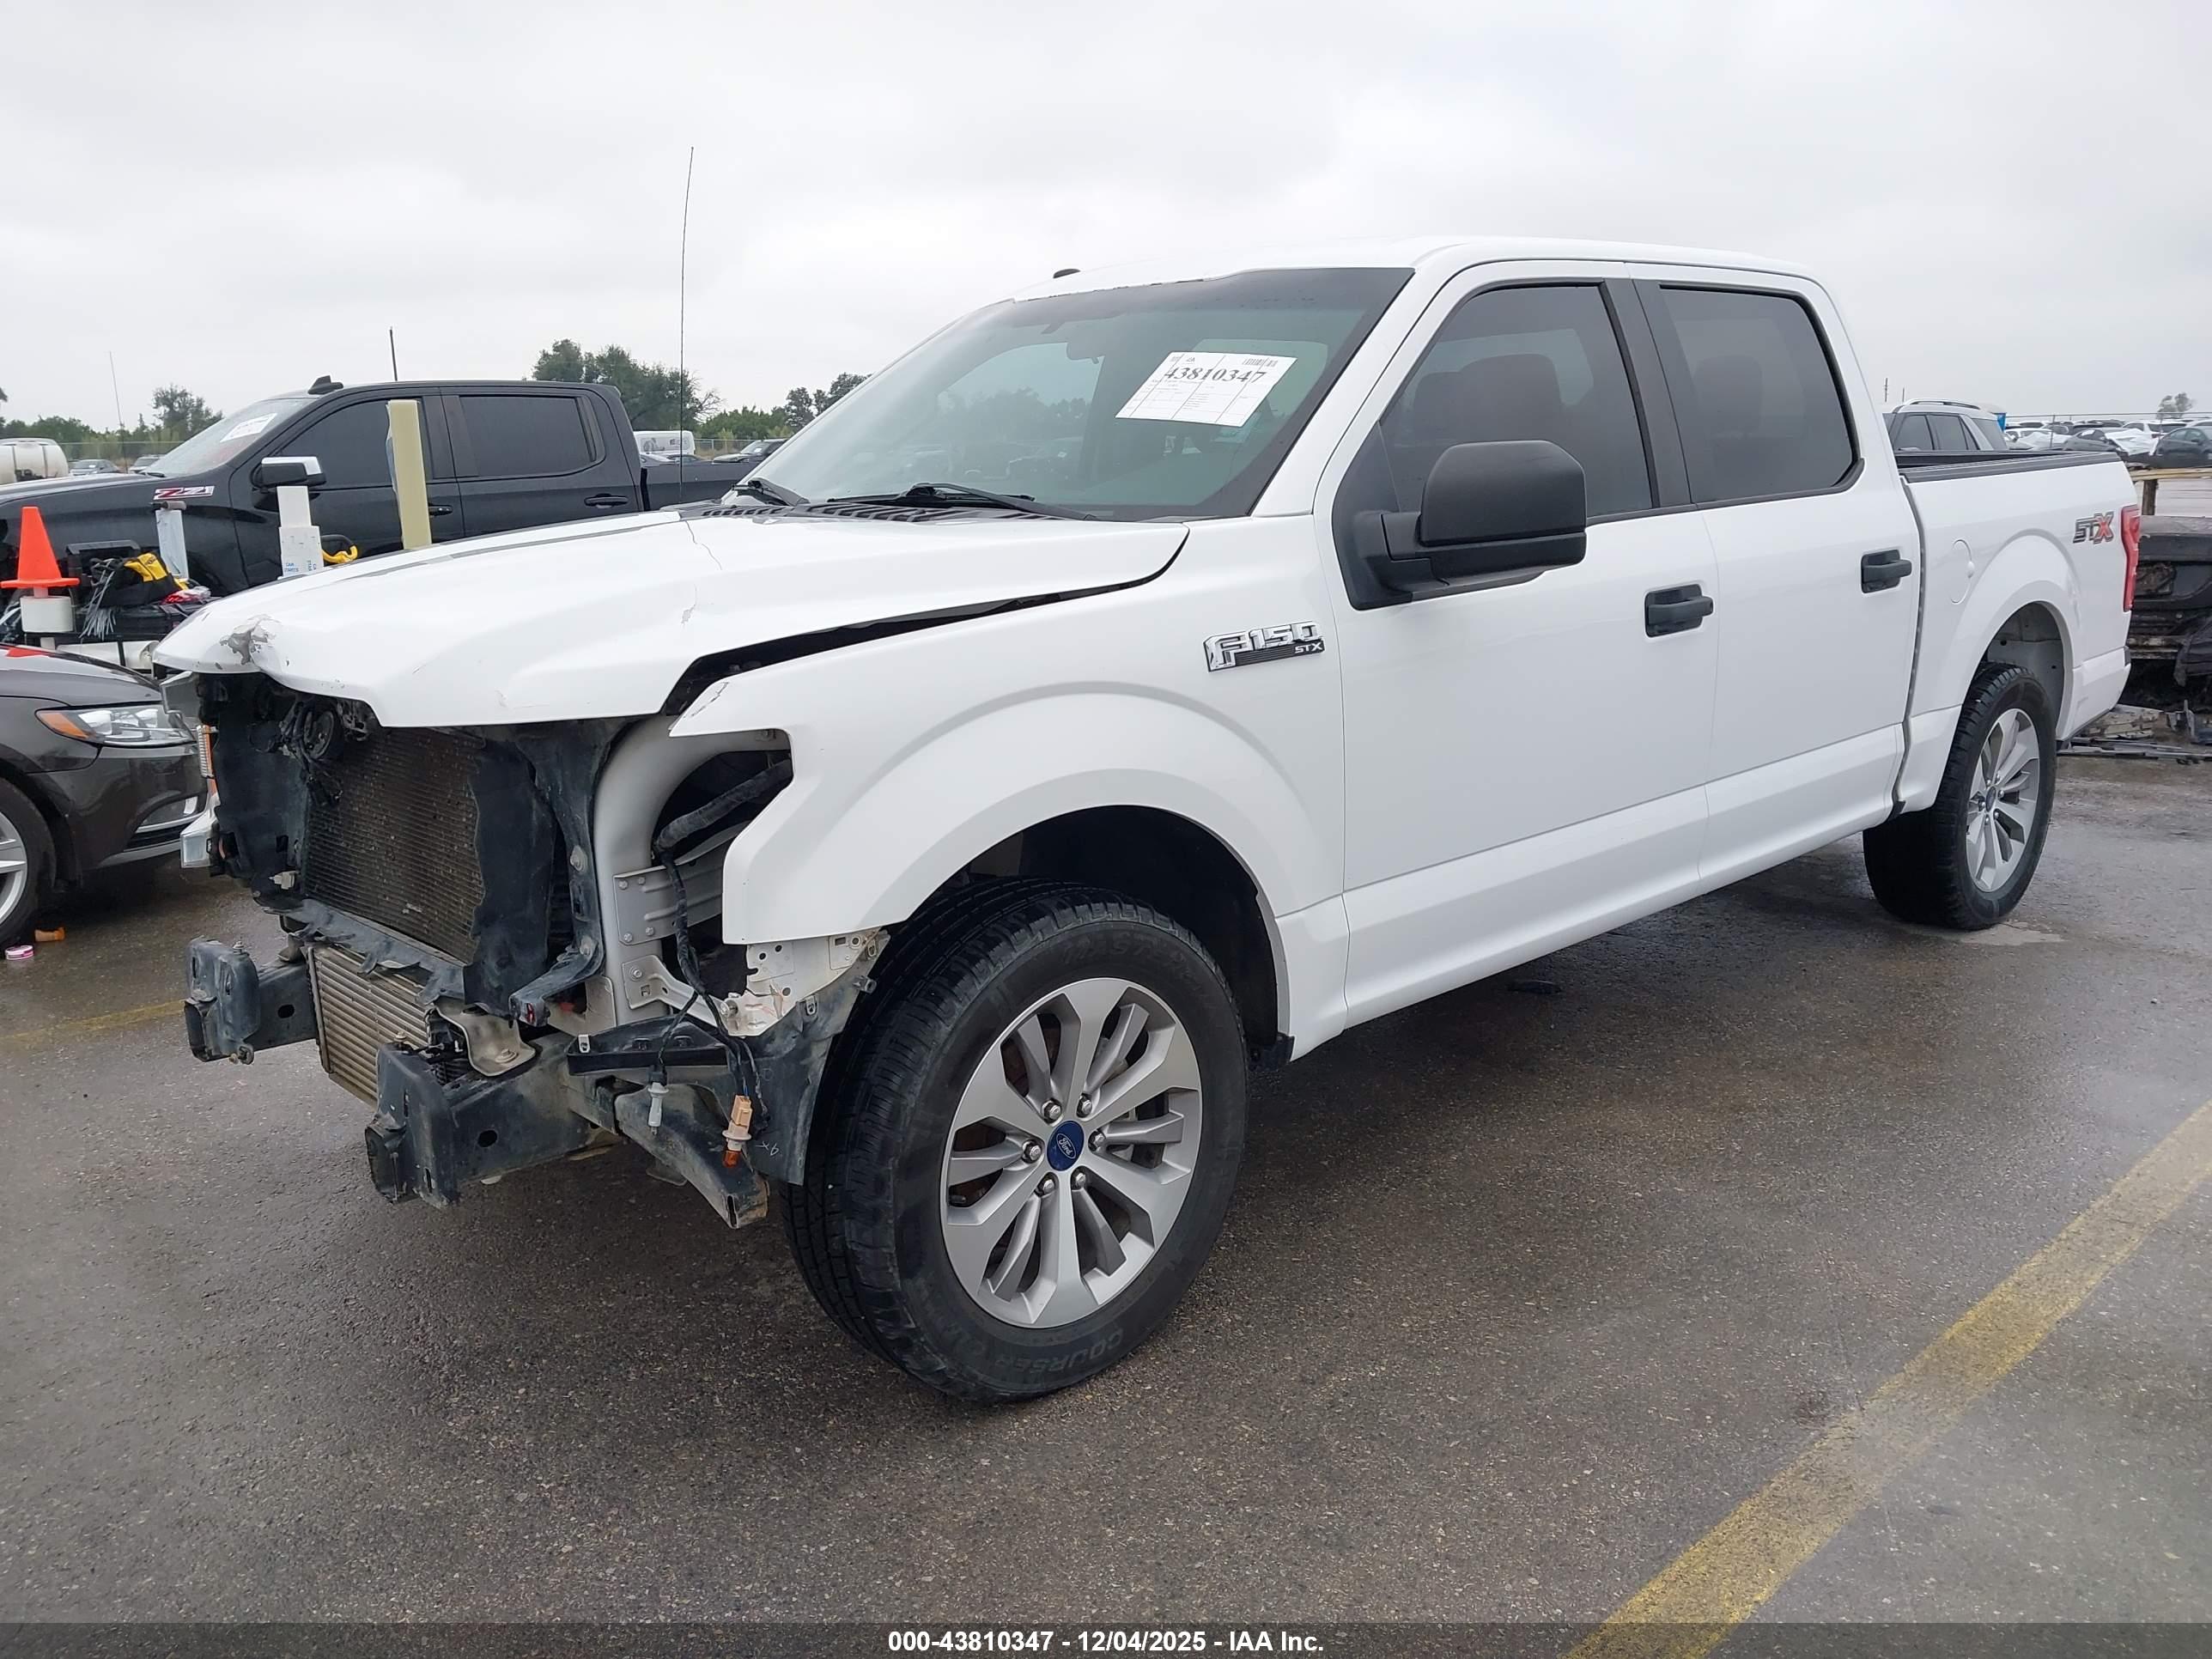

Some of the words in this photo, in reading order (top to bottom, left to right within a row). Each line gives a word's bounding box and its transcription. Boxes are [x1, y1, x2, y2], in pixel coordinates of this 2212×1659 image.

[1164, 367, 1267, 384] 43810347
[2073, 511, 2114, 544] STX
[1295, 641, 1323, 654] STX
